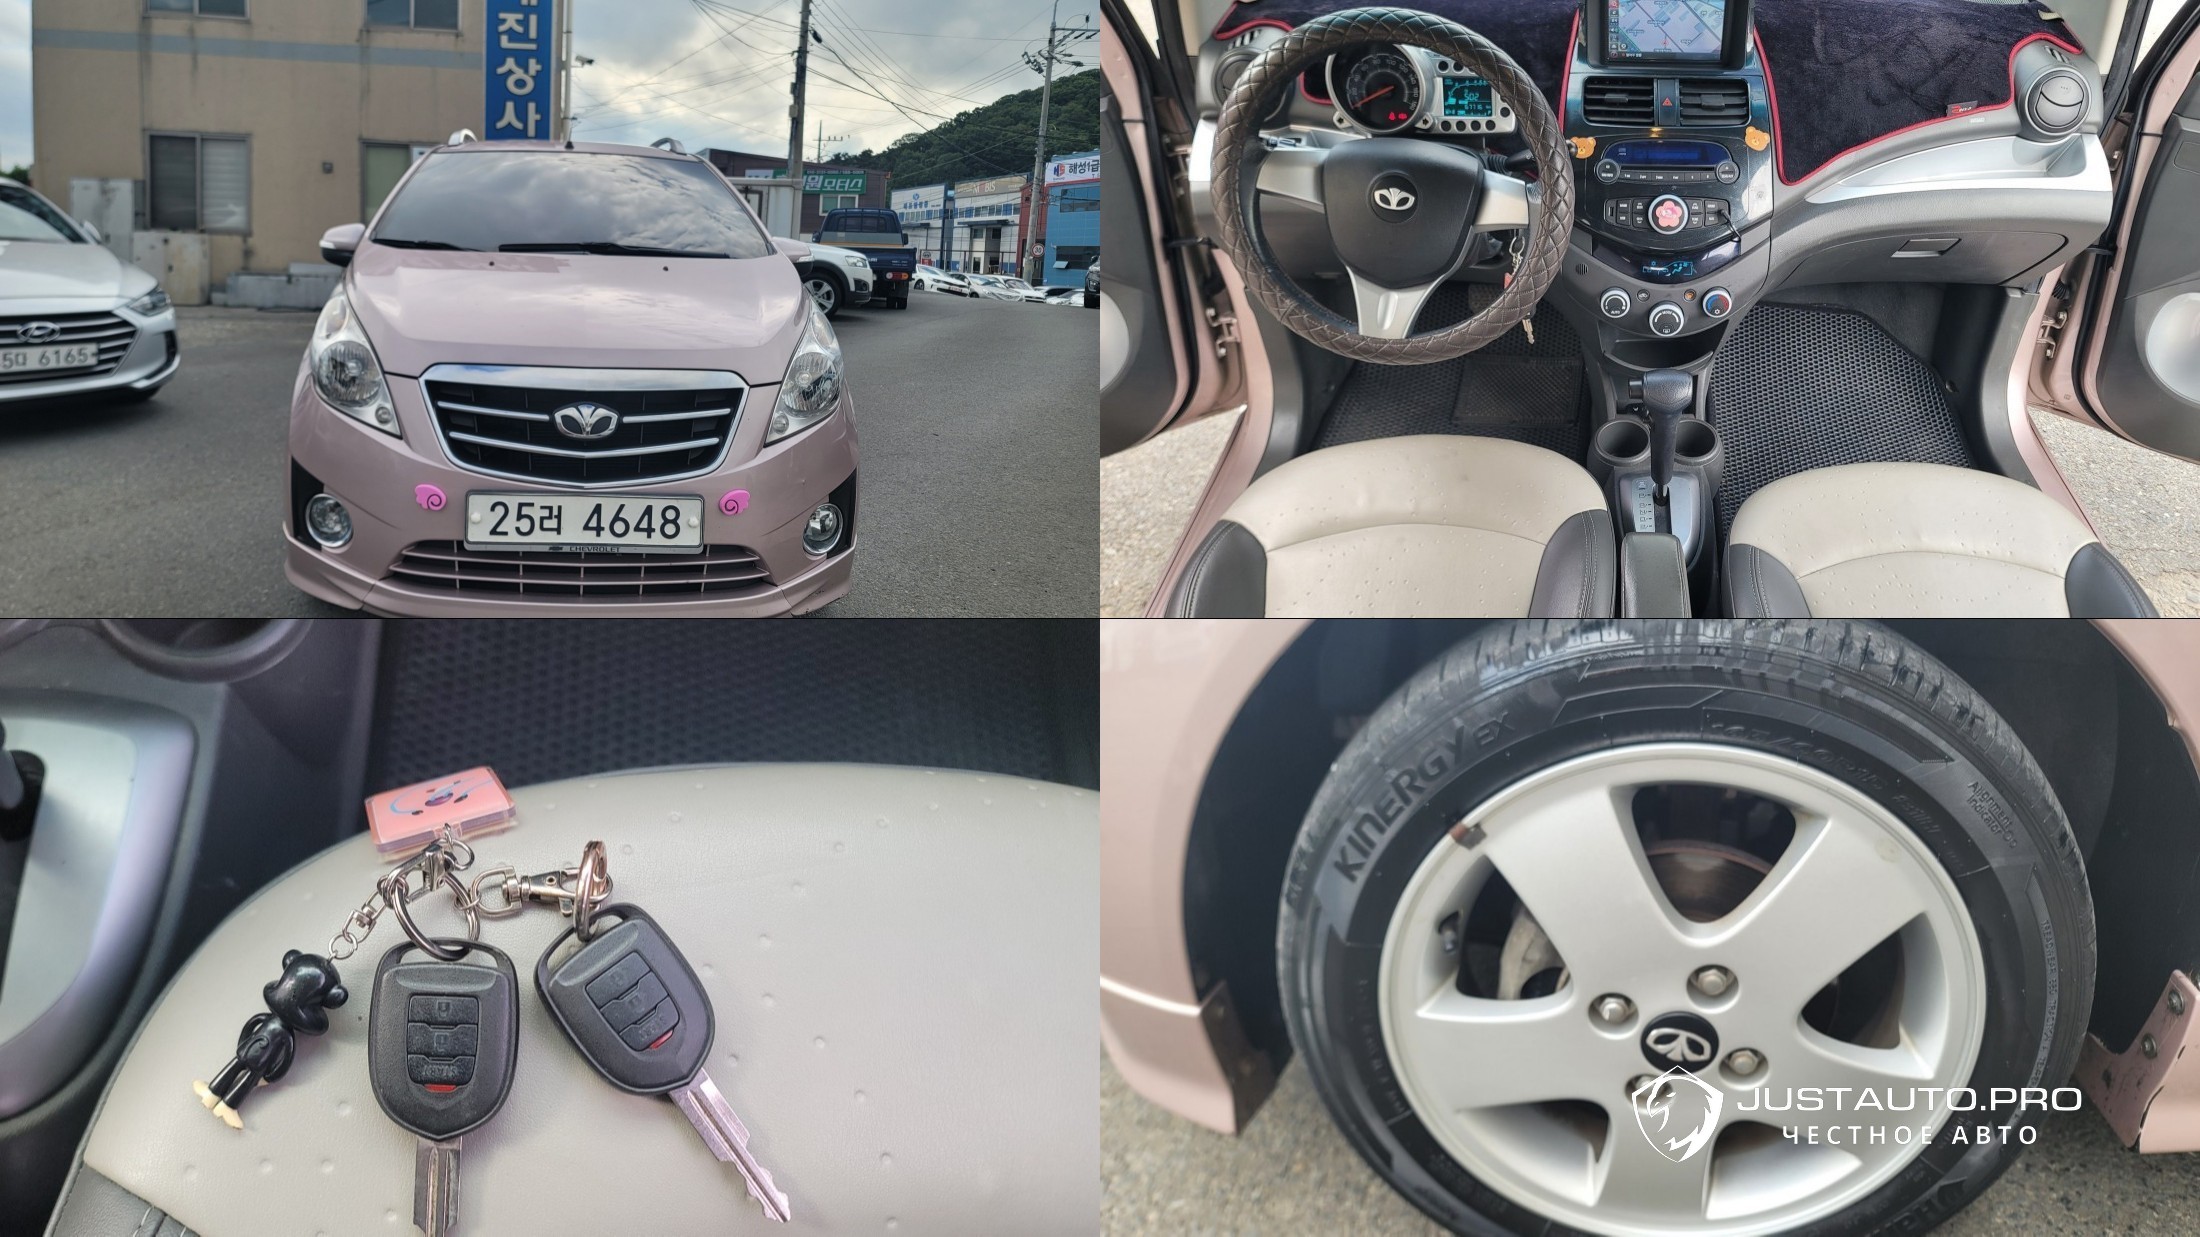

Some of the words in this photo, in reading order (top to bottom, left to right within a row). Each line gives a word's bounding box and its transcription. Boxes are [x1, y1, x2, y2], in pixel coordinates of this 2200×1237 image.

[496, 0, 541, 137] 진상사
[822, 178, 862, 191] 모터스
[39, 346, 89, 368] 6165
[489, 501, 562, 536] 25러
[582, 503, 681, 539] 4648
[1333, 717, 1464, 883] KINERGY
[1966, 795, 2002, 835] Indicator
[1967, 781, 2013, 829] Alignment
